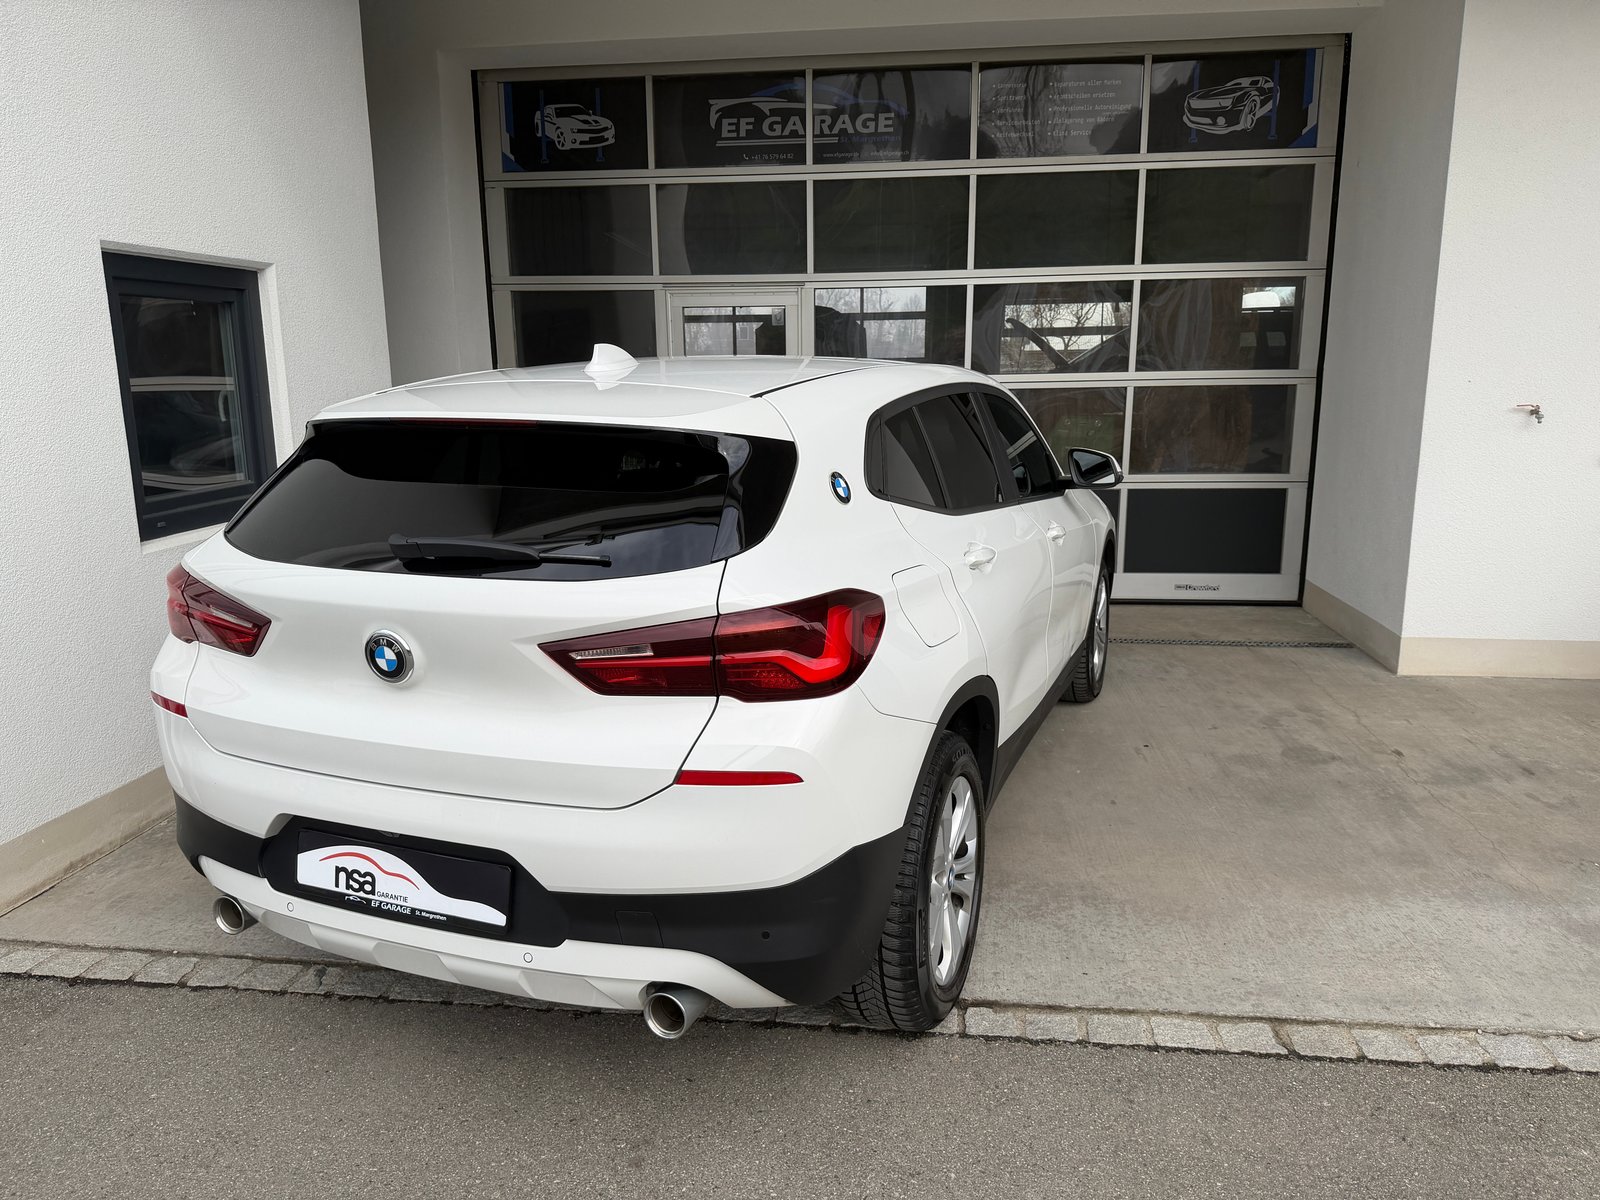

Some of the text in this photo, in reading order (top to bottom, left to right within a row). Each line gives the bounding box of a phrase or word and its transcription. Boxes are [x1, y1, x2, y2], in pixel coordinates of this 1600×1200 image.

[721, 112, 895, 138] EF GARAGE
[370, 638, 400, 653] BMW
[335, 865, 376, 897] nsa
[377, 891, 409, 904] GARANTIE
[371, 900, 380, 908] EF
[381, 901, 412, 915] GARAGE
